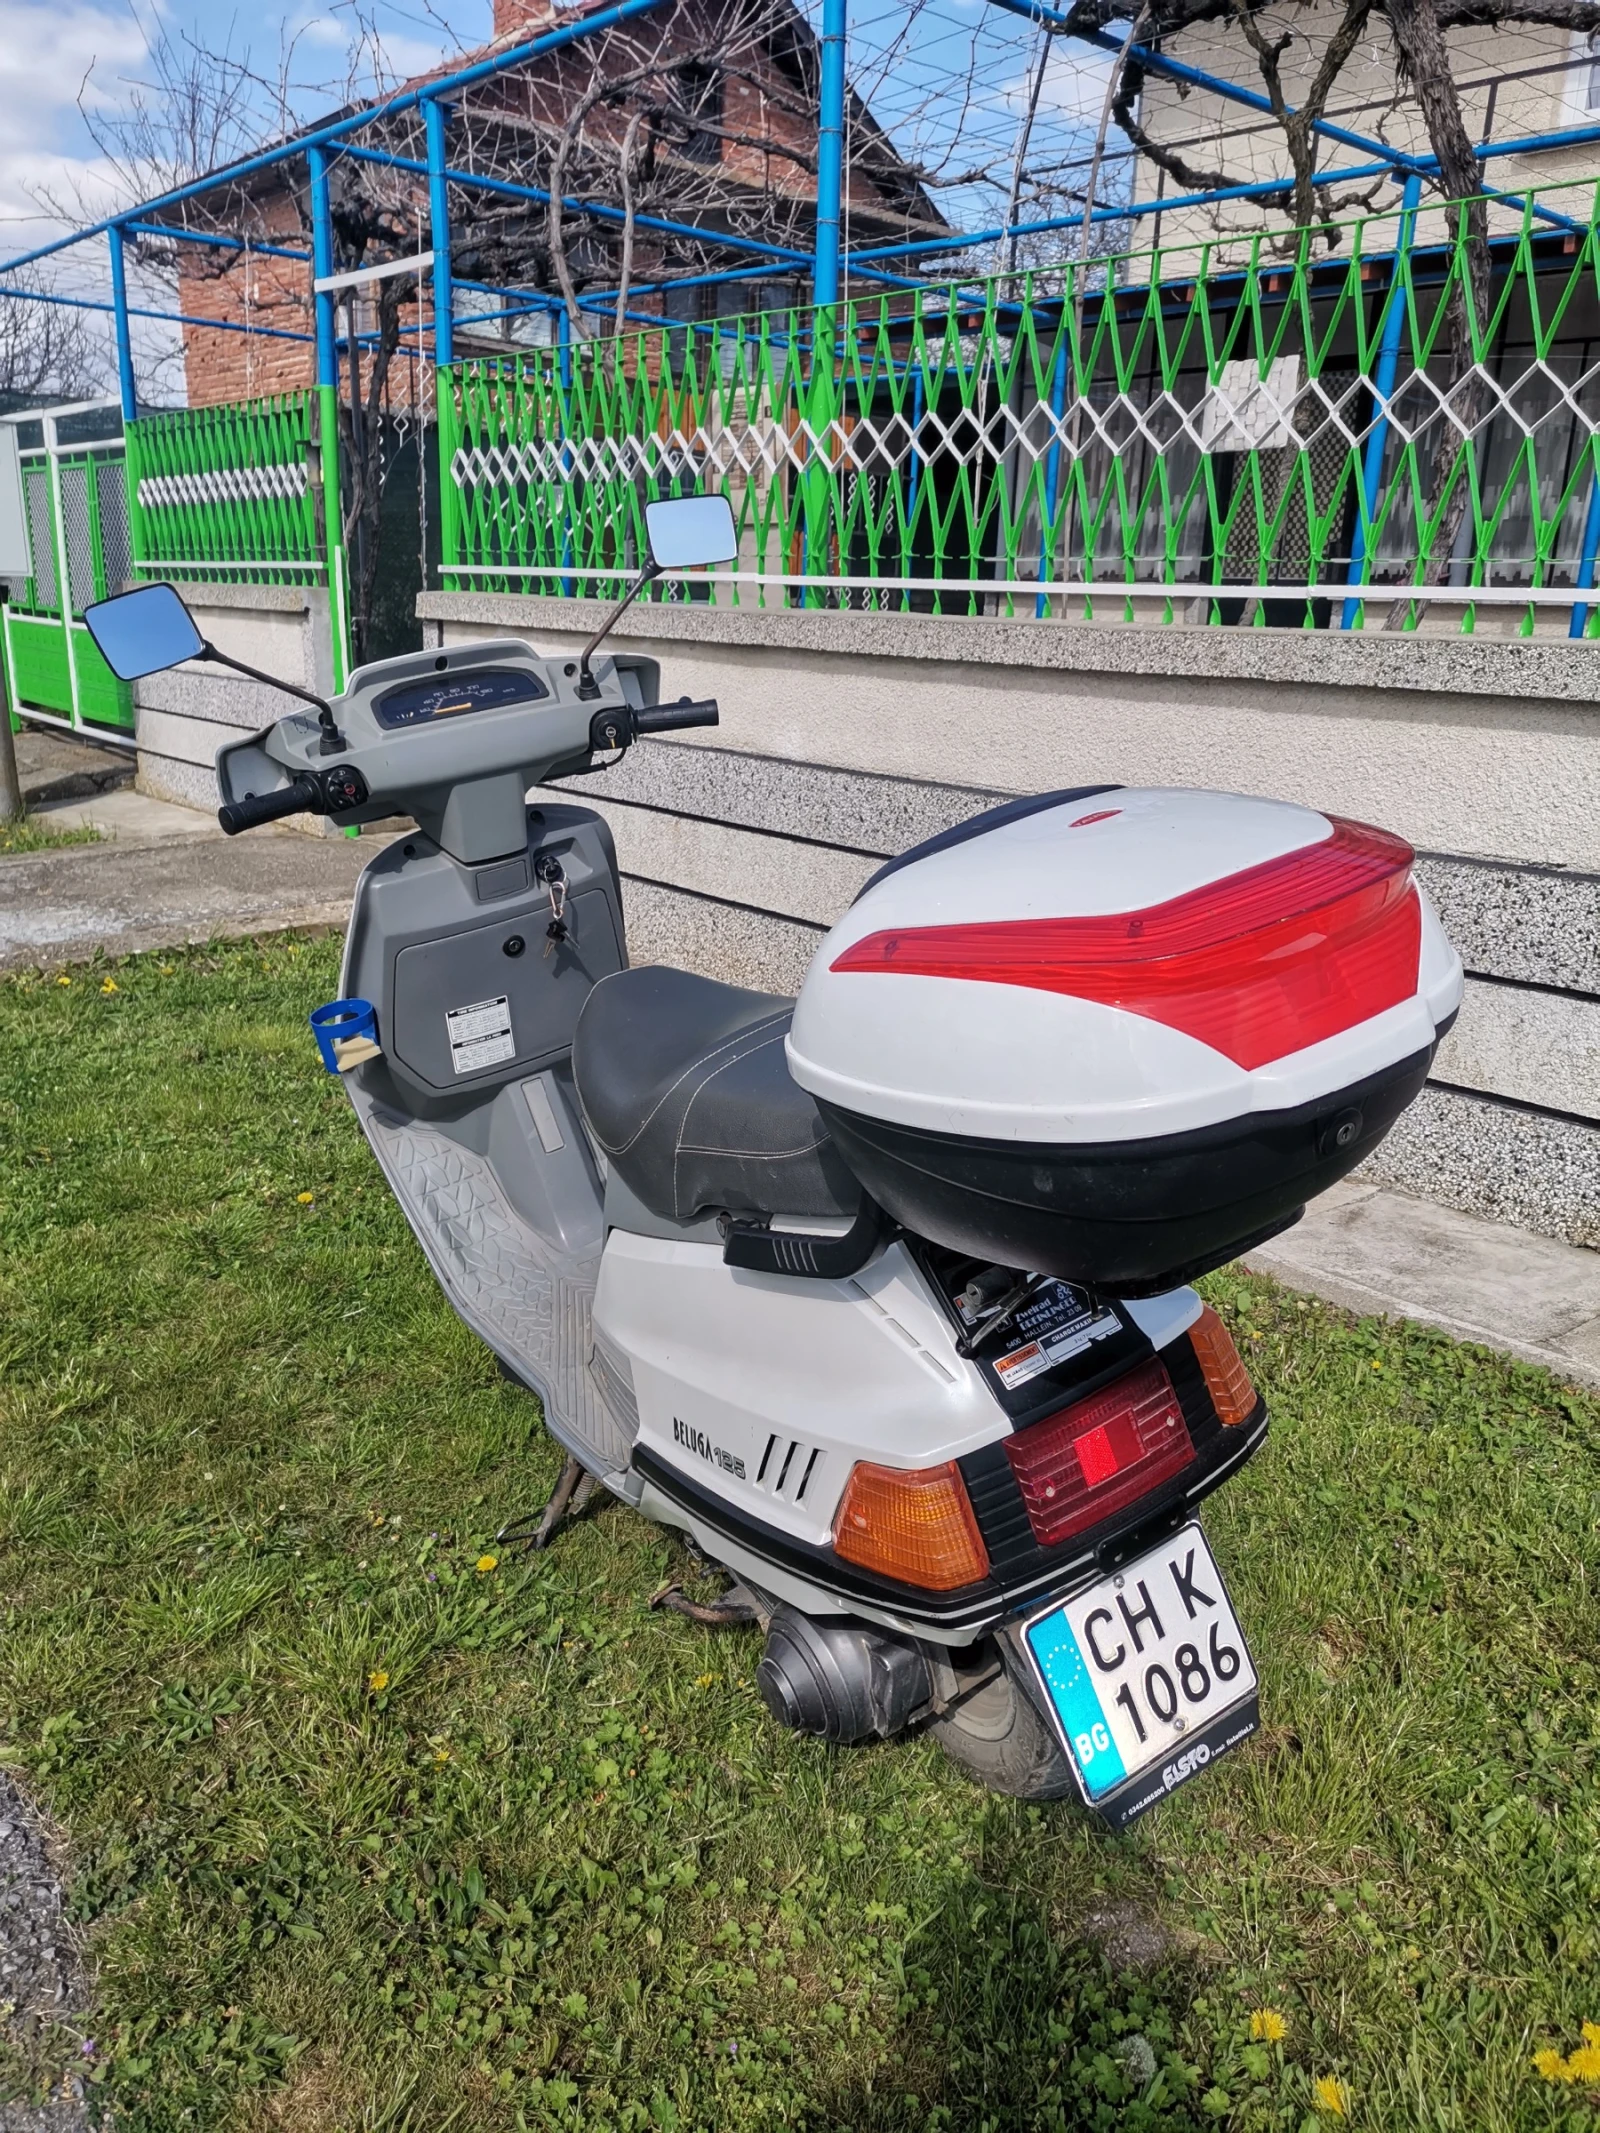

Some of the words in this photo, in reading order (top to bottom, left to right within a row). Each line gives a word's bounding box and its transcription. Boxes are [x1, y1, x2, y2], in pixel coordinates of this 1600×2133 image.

[1005, 1336, 1022, 1349] 5400
[1023, 1319, 1054, 1340] HALLEIN,
[1054, 1312, 1066, 1323] Tel.
[1013, 1297, 1051, 1322] Zweirad
[1050, 1325, 1076, 1343] CHARGE
[673, 1416, 714, 1464] BELUGA
[714, 1447, 746, 1480] 125
[1084, 1579, 1166, 1673] CH
[1167, 1548, 1217, 1620] K
[1114, 1621, 1241, 1744] 1086
[1074, 1722, 1110, 1766] BG
